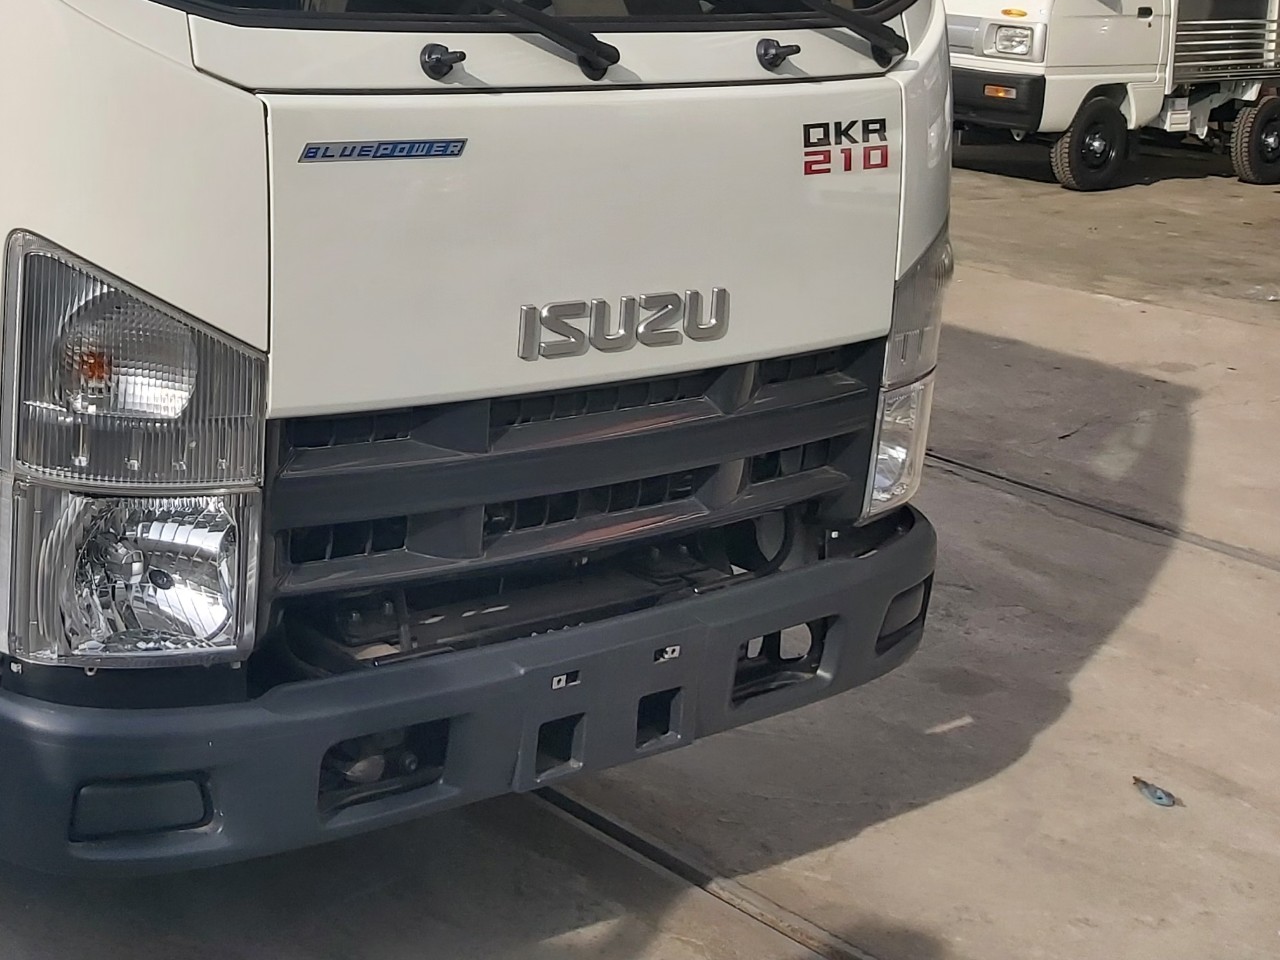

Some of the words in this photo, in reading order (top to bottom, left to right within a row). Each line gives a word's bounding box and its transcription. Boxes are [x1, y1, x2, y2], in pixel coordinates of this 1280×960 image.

[803, 118, 888, 148] QKR
[804, 144, 888, 175] 210
[517, 286, 730, 362] ISUZU
